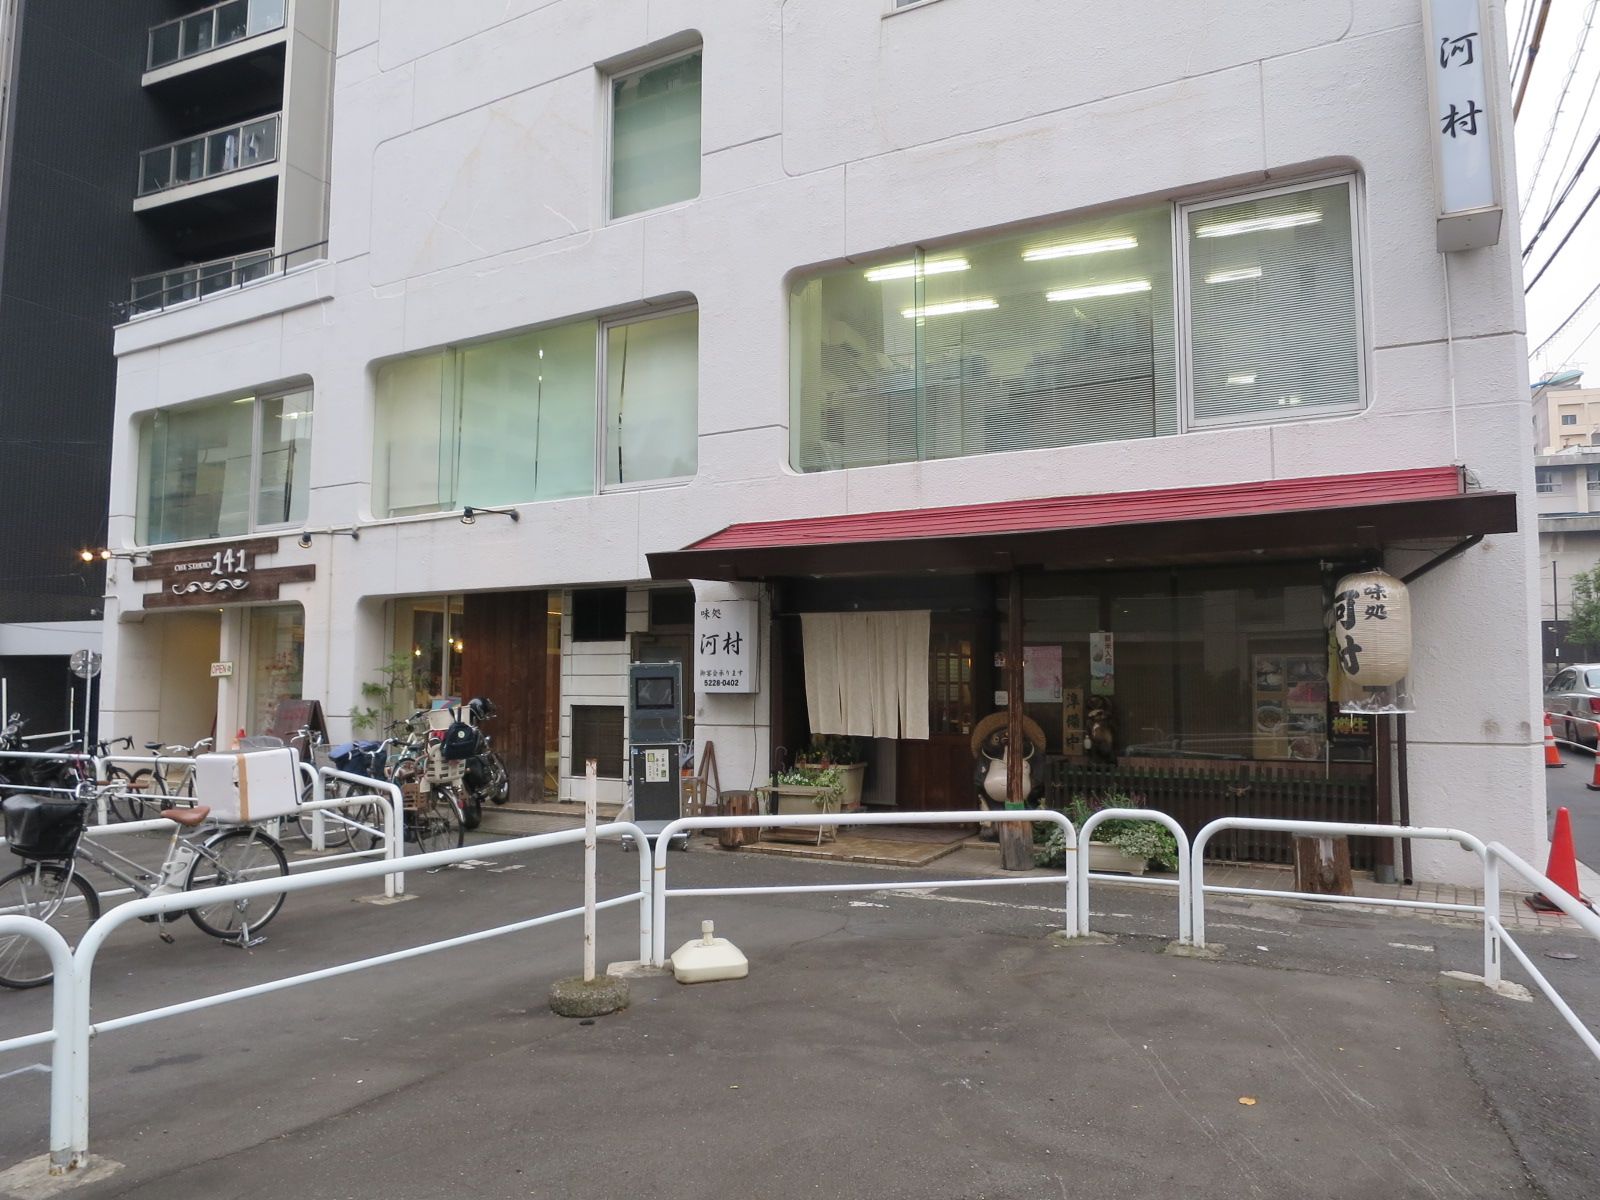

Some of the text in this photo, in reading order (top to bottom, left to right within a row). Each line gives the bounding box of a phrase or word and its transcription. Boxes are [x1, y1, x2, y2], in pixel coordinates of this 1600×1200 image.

[1440, 32, 1482, 139] 河村
[211, 548, 248, 575] 141
[700, 607, 721, 620] 味処
[1364, 583, 1387, 621] 味処
[700, 631, 743, 655] 河村
[212, 664, 226, 674] OPEN
[704, 679, 739, 687] 5228-0402
